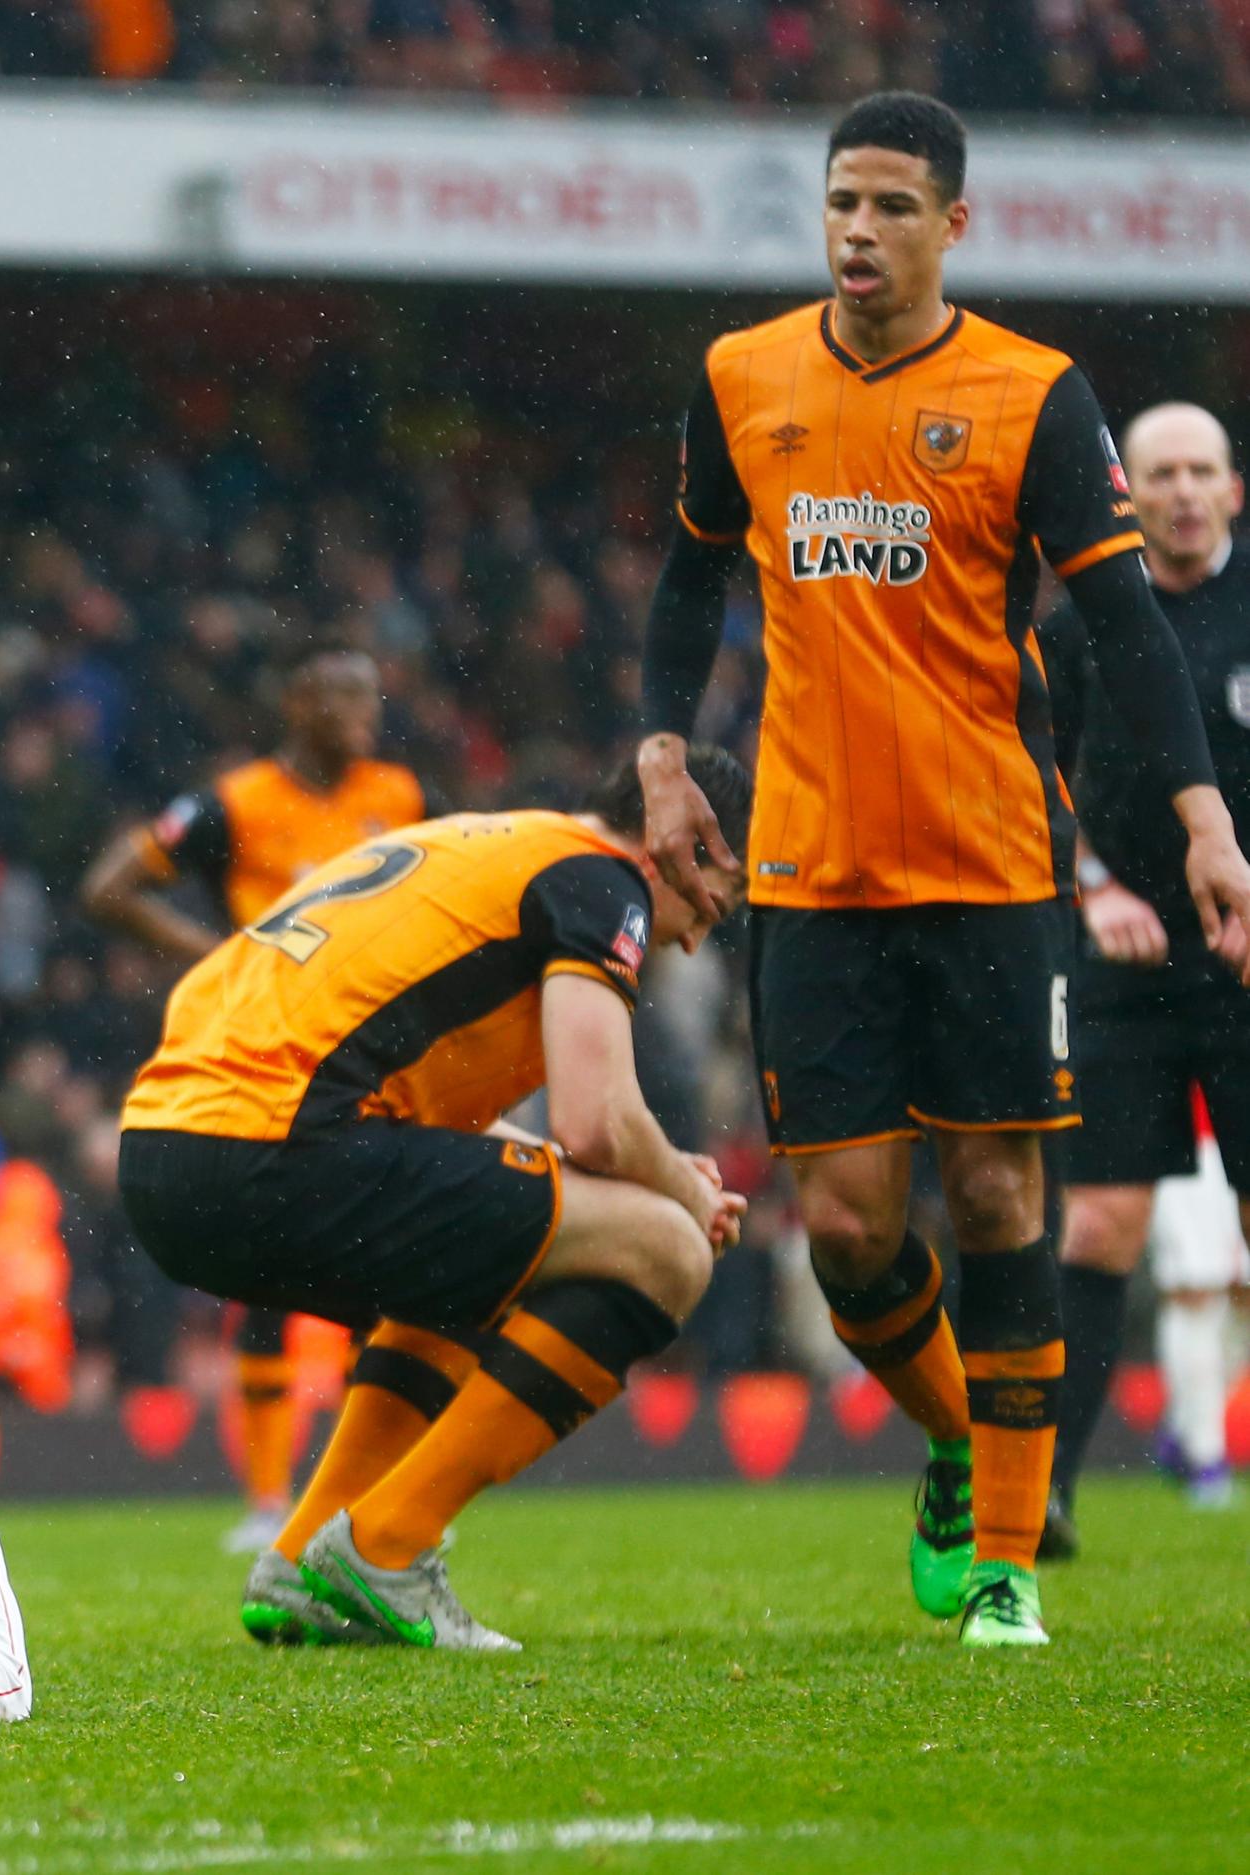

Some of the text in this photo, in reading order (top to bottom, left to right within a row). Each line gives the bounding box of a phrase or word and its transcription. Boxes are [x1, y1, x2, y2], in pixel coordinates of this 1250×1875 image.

[789, 490, 931, 536] flamingo
[791, 534, 927, 585] LAND
[244, 840, 426, 965] 2
[1051, 975, 1069, 1061] 6
